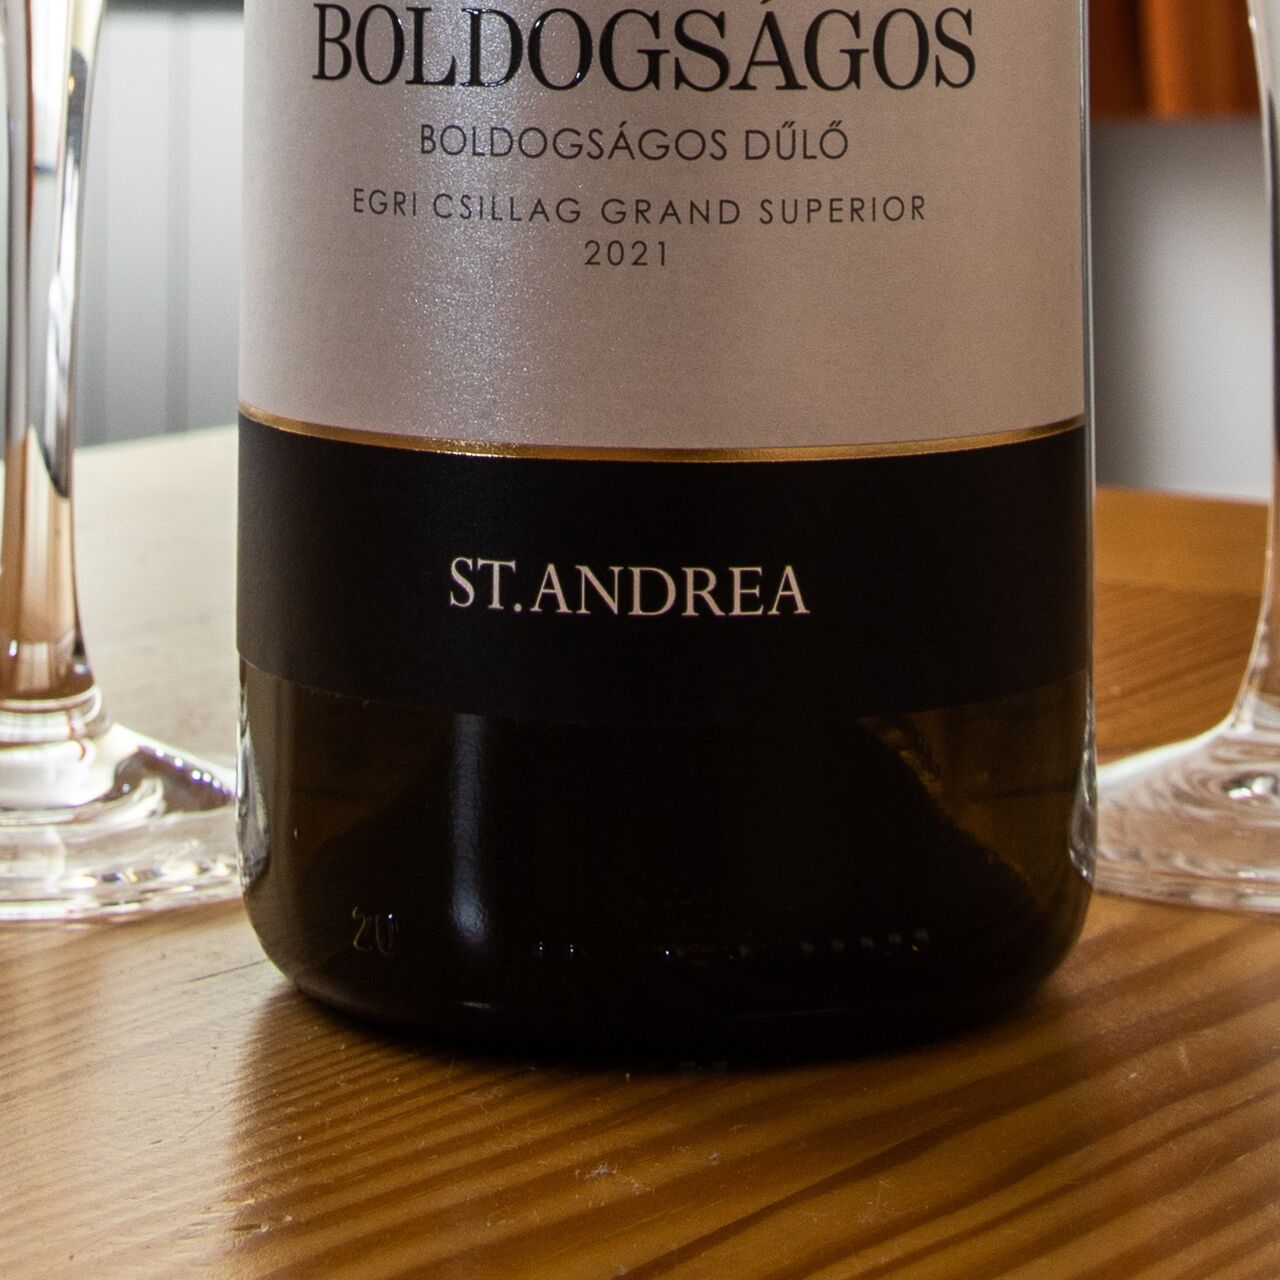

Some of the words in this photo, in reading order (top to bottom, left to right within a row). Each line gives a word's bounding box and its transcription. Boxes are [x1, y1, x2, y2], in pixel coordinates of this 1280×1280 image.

[419, 120, 728, 162] BOLDOGSÁGOS
[744, 120, 850, 161] DŰLŐ
[352, 187, 418, 217] EGRI
[432, 192, 581, 225] CSILLAG
[600, 198, 741, 226] GRAND
[759, 194, 926, 225] SUPERIOR
[584, 239, 667, 268] 2021
